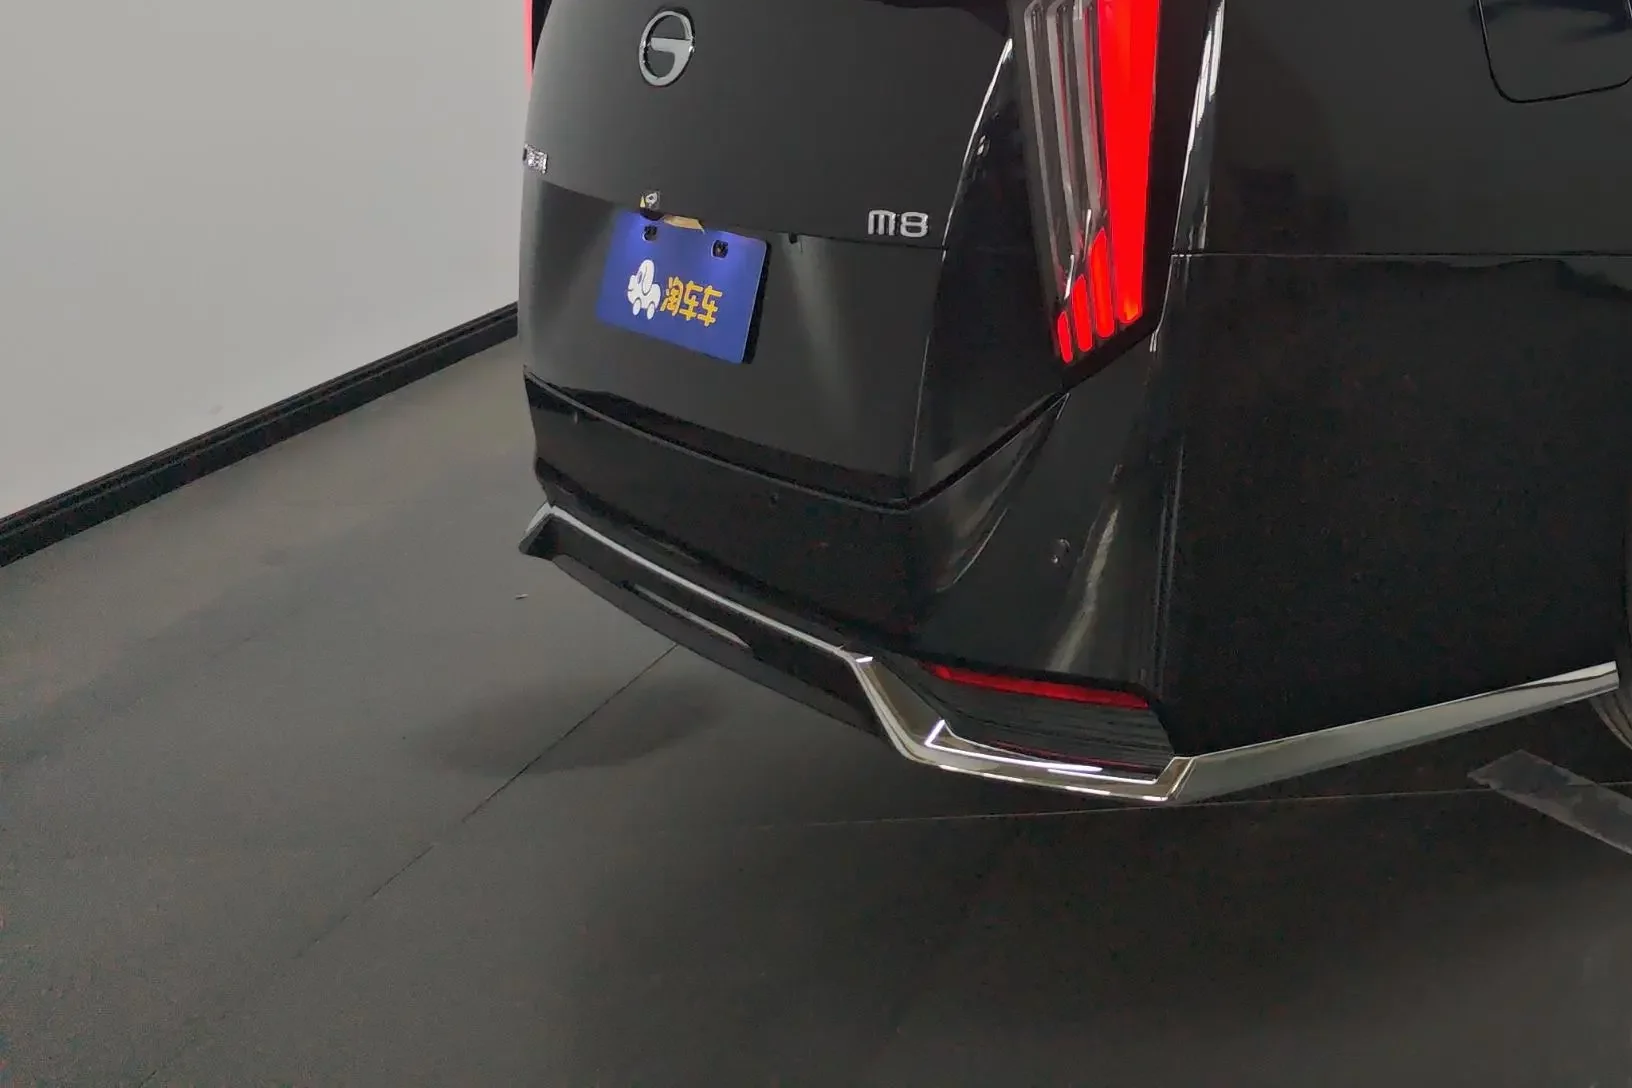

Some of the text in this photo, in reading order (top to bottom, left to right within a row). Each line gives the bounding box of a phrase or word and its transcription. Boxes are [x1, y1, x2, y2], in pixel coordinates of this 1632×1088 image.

[867, 209, 929, 238] M8
[660, 276, 723, 327] 淘车车
